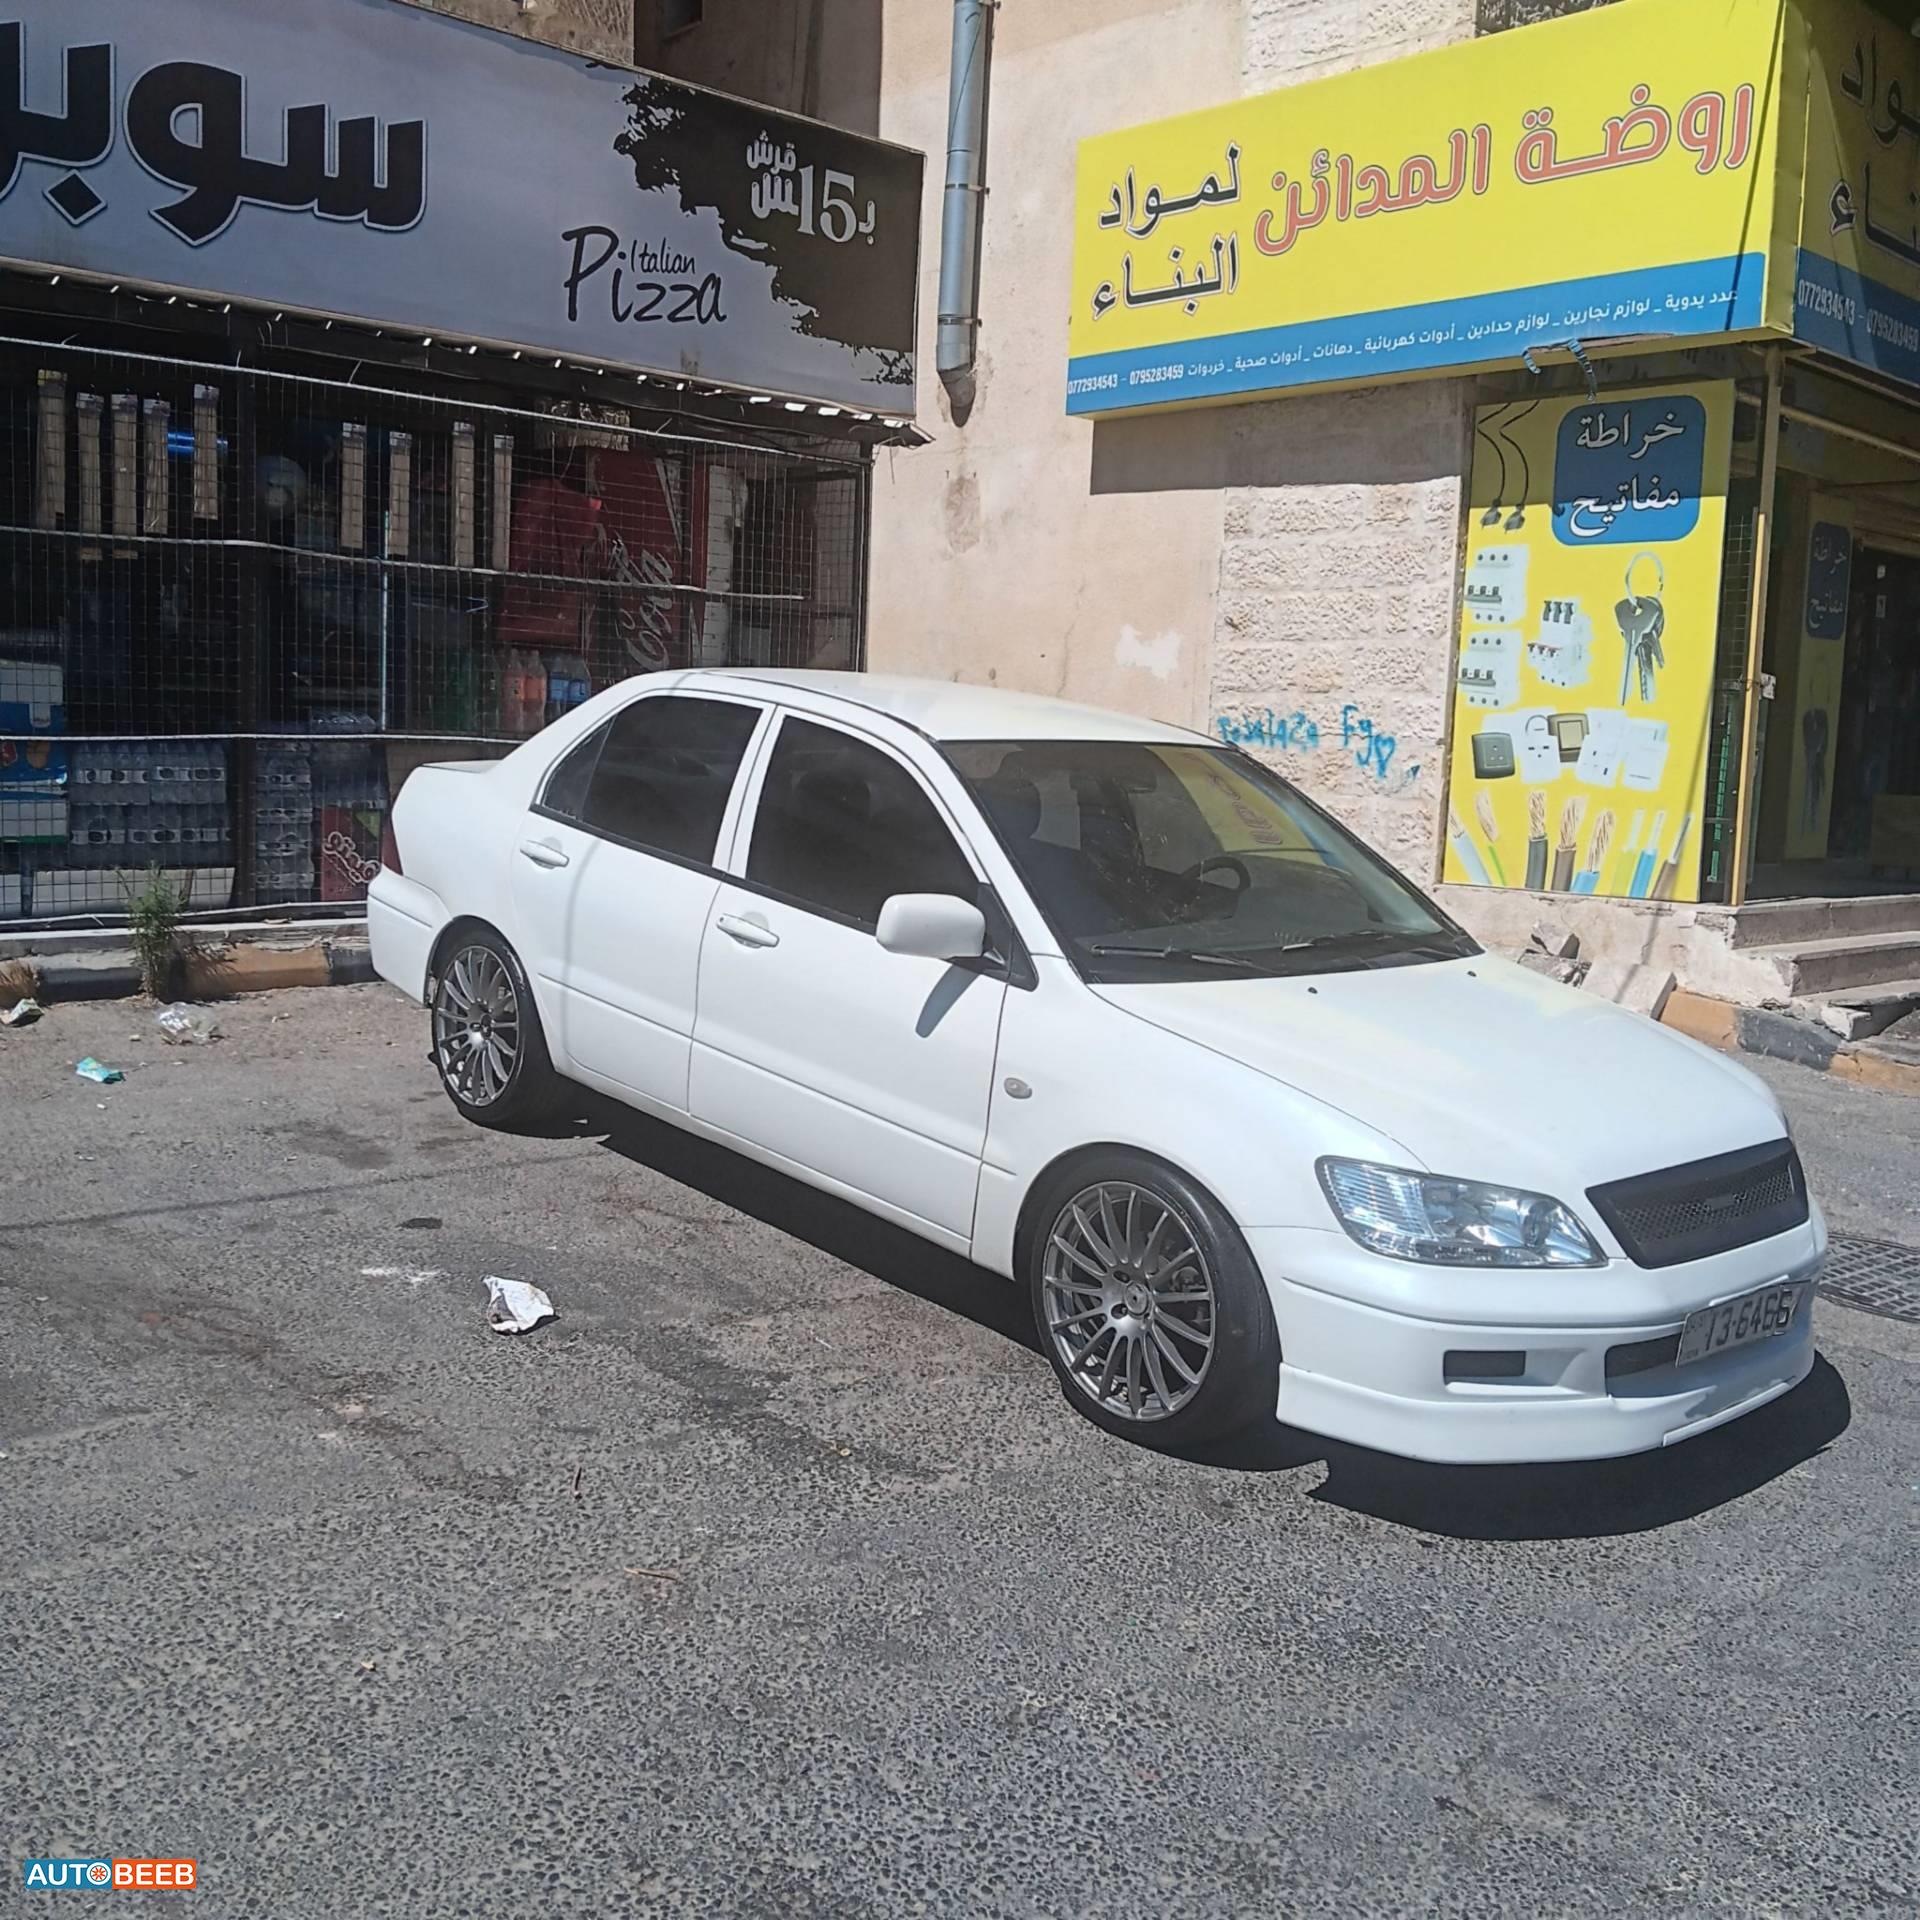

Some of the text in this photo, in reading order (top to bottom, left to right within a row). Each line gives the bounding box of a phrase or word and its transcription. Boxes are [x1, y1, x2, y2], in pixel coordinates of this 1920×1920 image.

[746, 129, 797, 175] قرش
[1254, 84, 1754, 256] روضة المدائن
[1098, 139, 1241, 239] لمواد
[630, 237, 696, 275] Italian
[561, 225, 727, 324] Pizza
[1091, 231, 1239, 320] البناء
[1564, 302, 1609, 325] نجارين
[1613, 298, 1650, 321] لوازم
[1665, 293, 1704, 311] يدوية
[1798, 279, 1855, 326] 0772934543
[1419, 323, 1455, 344] أدوات
[1467, 320, 1512, 340] حدادين
[1515, 312, 1550, 334] لوازم
[1235, 353, 1267, 370] صحية
[1269, 345, 1302, 366] أدوات
[1313, 342, 1353, 359] دهانات
[1129, 364, 1184, 386] 0795283459
[1188, 359, 1225, 377] خردوات
[1068, 373, 1118, 395] 0772934543
[1576, 409, 1686, 459] خراطة
[1569, 473, 1681, 538] مفاتيح
